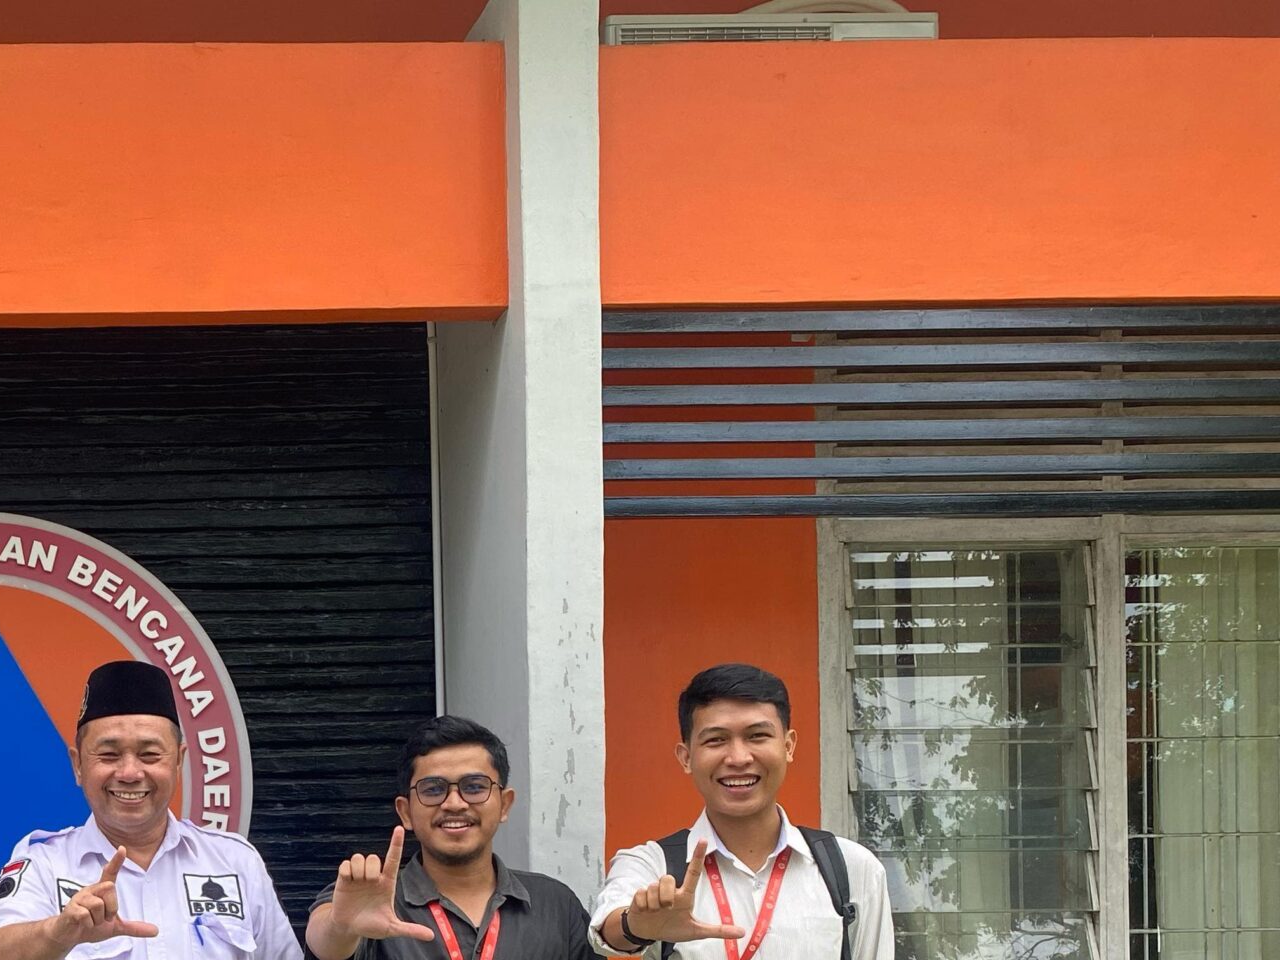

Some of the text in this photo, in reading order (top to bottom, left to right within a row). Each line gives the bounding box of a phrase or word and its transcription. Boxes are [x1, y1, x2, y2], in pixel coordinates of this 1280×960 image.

[67, 554, 215, 718] BENCANA
[197, 726, 231, 832] DAER
[193, 902, 240, 914] BPBD
